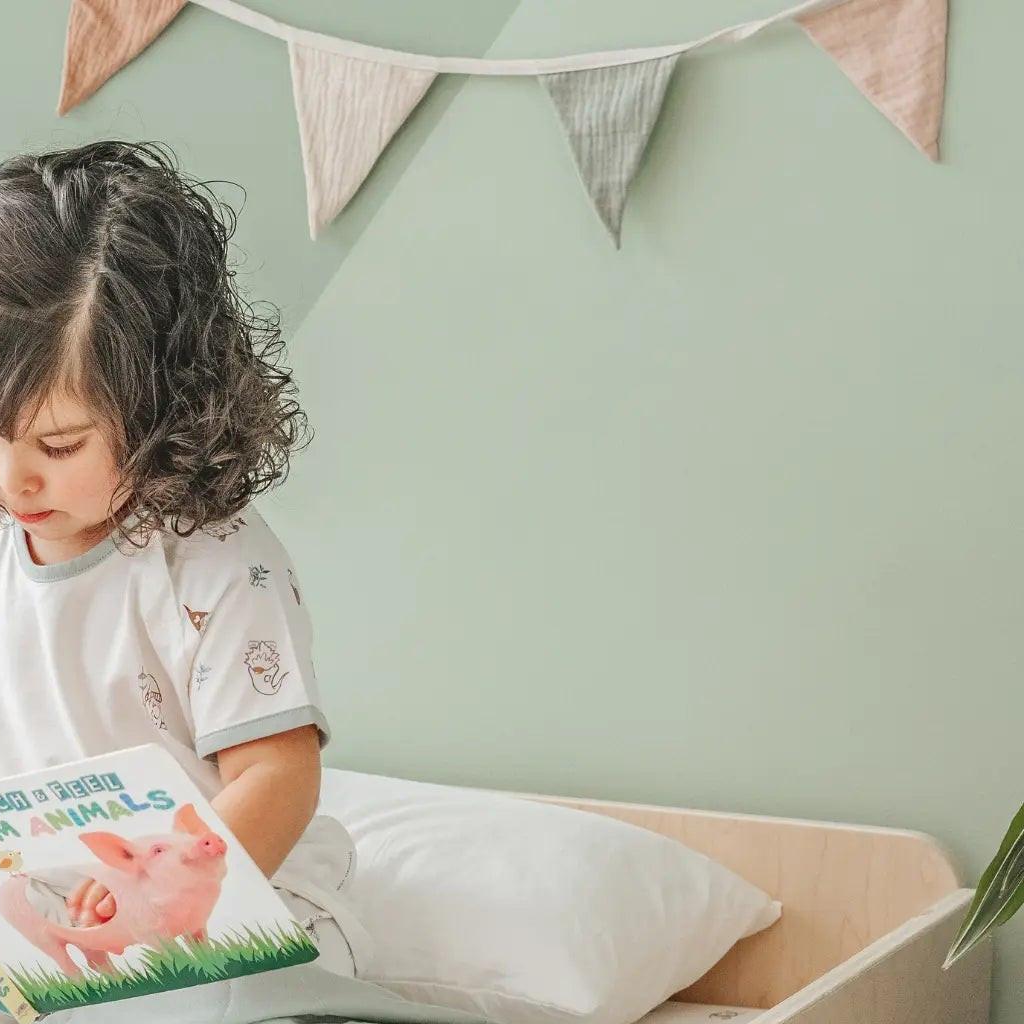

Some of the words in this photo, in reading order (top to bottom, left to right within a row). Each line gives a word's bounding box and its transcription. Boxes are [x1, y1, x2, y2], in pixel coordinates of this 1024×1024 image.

[32, 788, 50, 802] &
[46, 772, 125, 801] FEEL
[30, 789, 176, 837] ANIMALS
